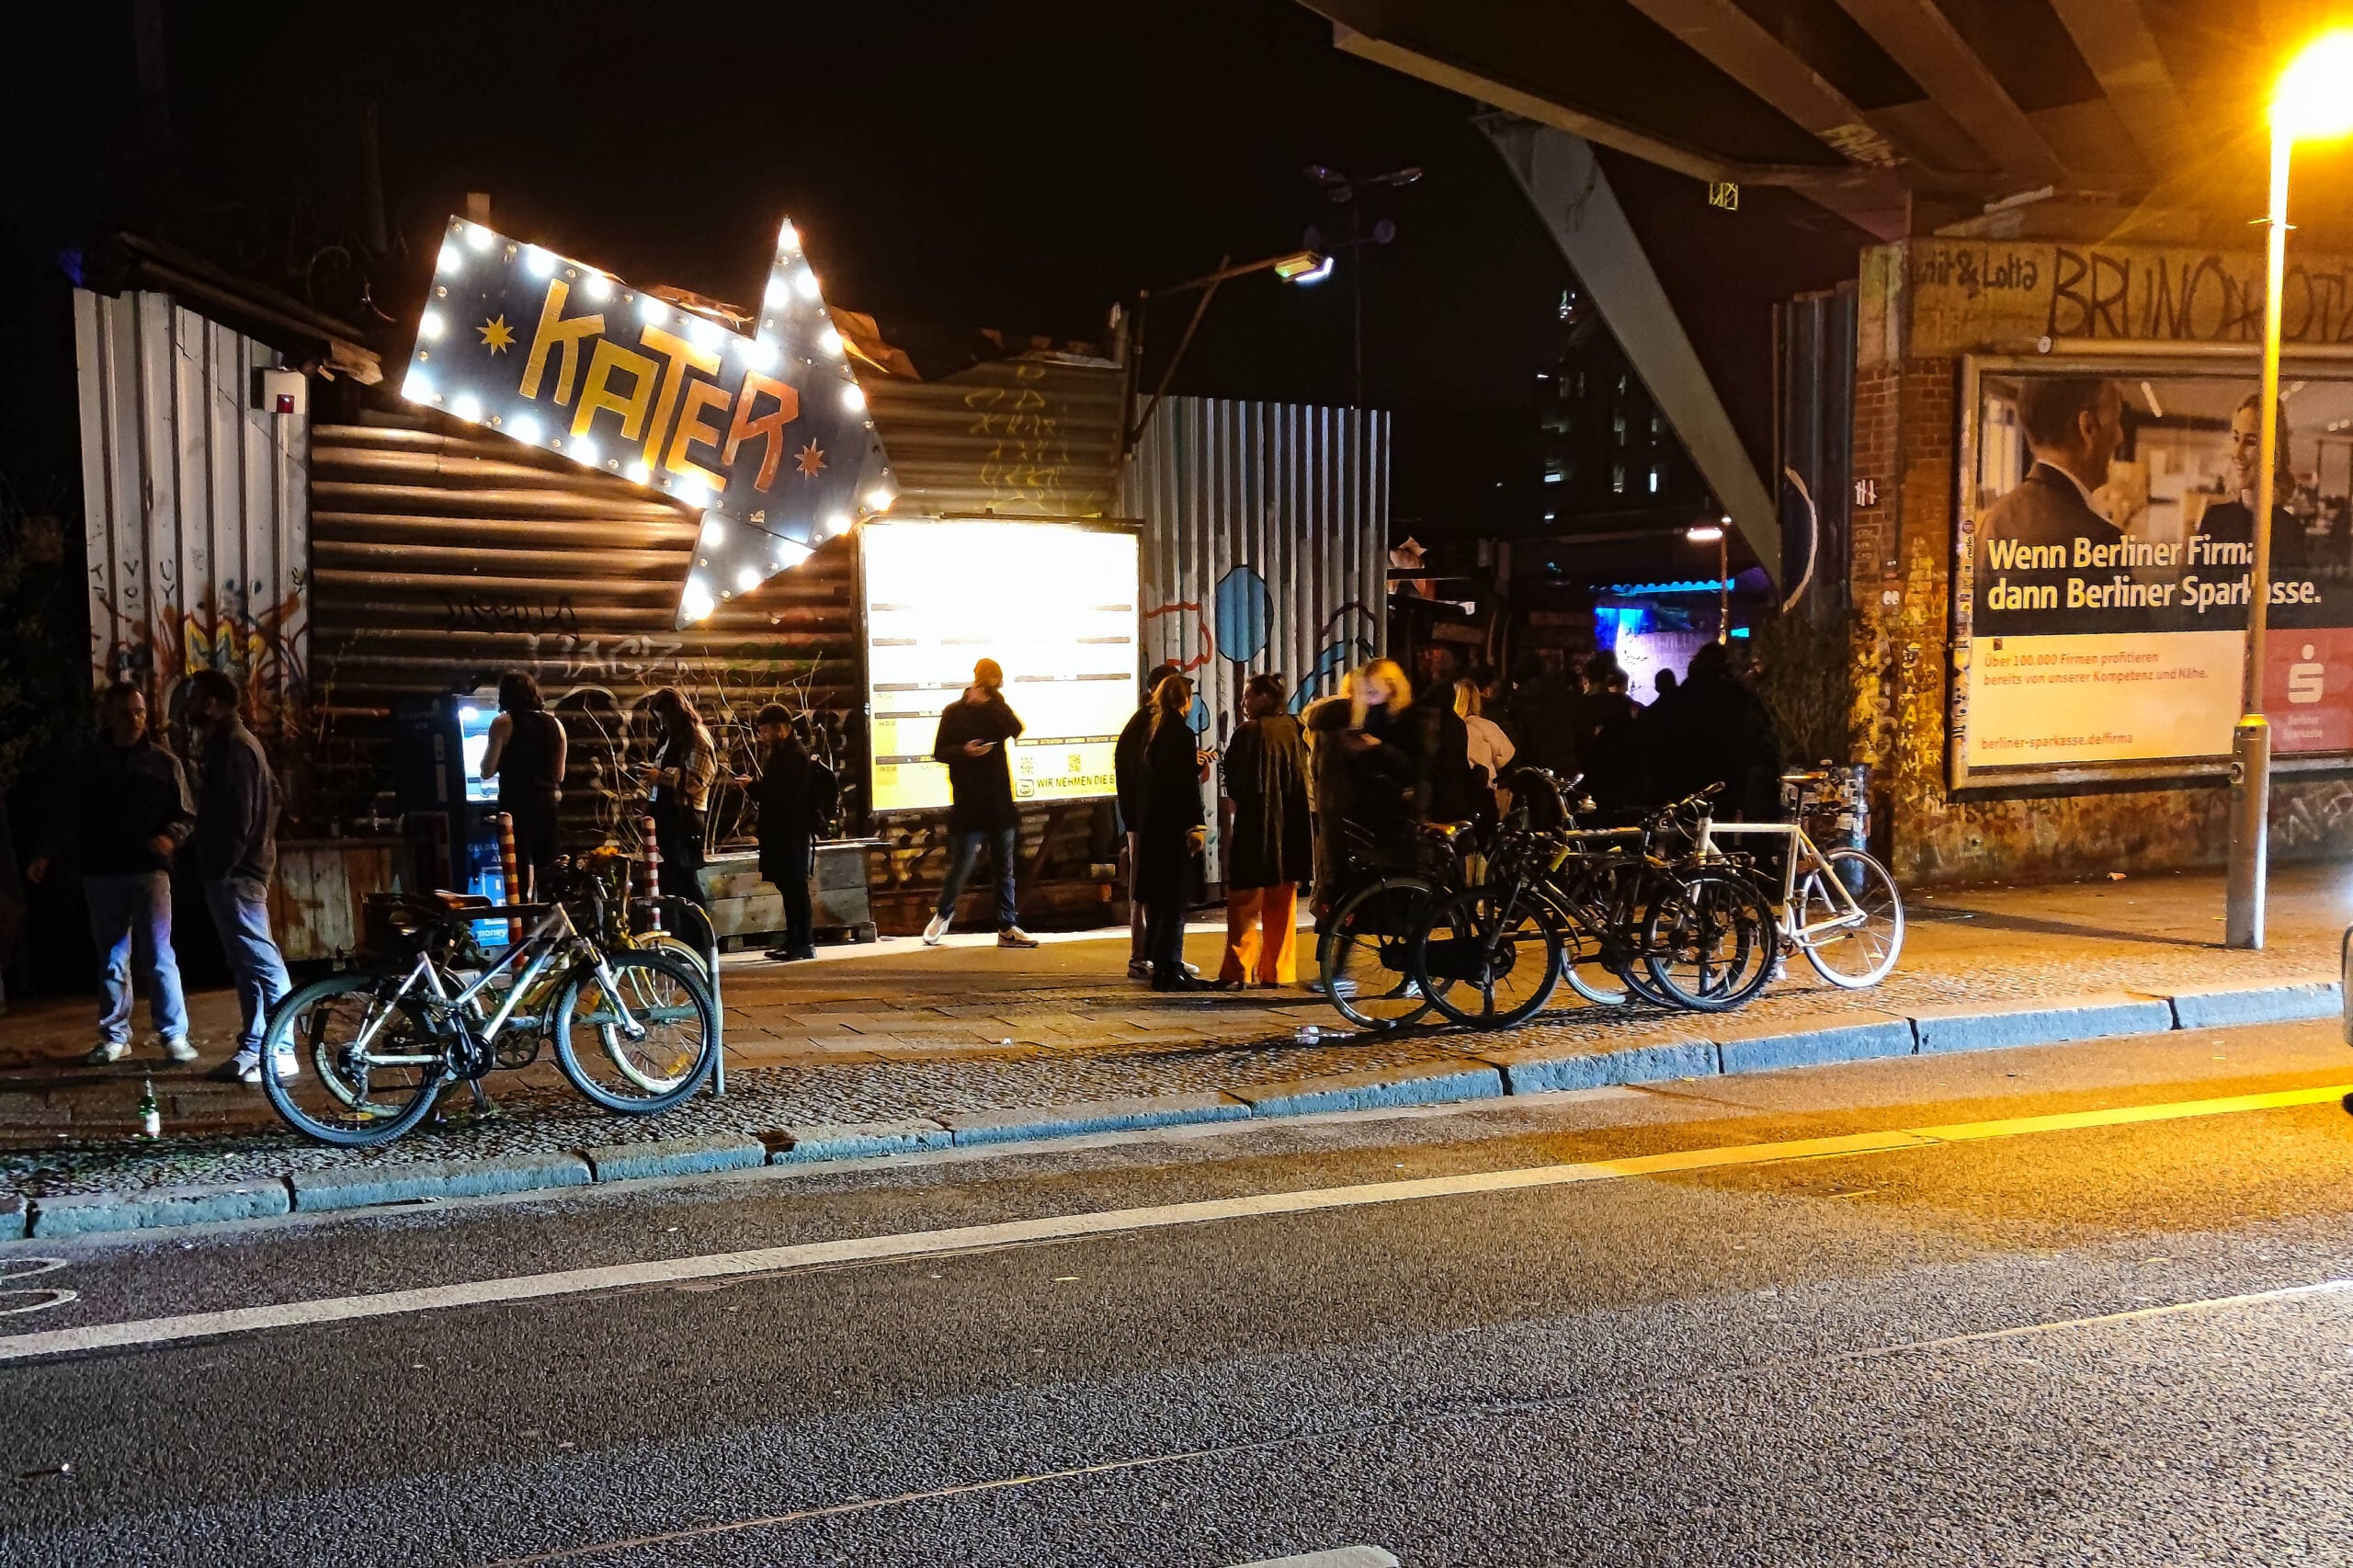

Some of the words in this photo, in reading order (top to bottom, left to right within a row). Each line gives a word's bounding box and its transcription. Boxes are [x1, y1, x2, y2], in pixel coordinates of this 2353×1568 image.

[2048, 246, 2228, 340] BRUNO
[518, 278, 799, 493] KATER
[1986, 538, 2066, 570] Wenn
[2074, 535, 2181, 568] Berliner
[1987, 578, 2058, 610] dann
[2067, 574, 2177, 608] Berliner
[2180, 574, 2322, 614] Sparksse.
[1984, 653, 2011, 667] Über
[2014, 653, 2057, 666] 100.000
[2061, 653, 2098, 665] Firmen
[2101, 652, 2159, 667] profitieren
[1984, 674, 2022, 686] bereits
[2025, 675, 2045, 684] von
[2048, 673, 2090, 684] unserer
[2093, 671, 2153, 684] Kompetenz
[2156, 668, 2177, 679] und
[2178, 667, 2208, 678] Nähe.
[1982, 733, 2133, 749] berliner-sparkasse.de/firma
[1037, 778, 1053, 788] WIR
[1055, 777, 1093, 788] NEHMEN
[1094, 775, 1108, 785] DIE
